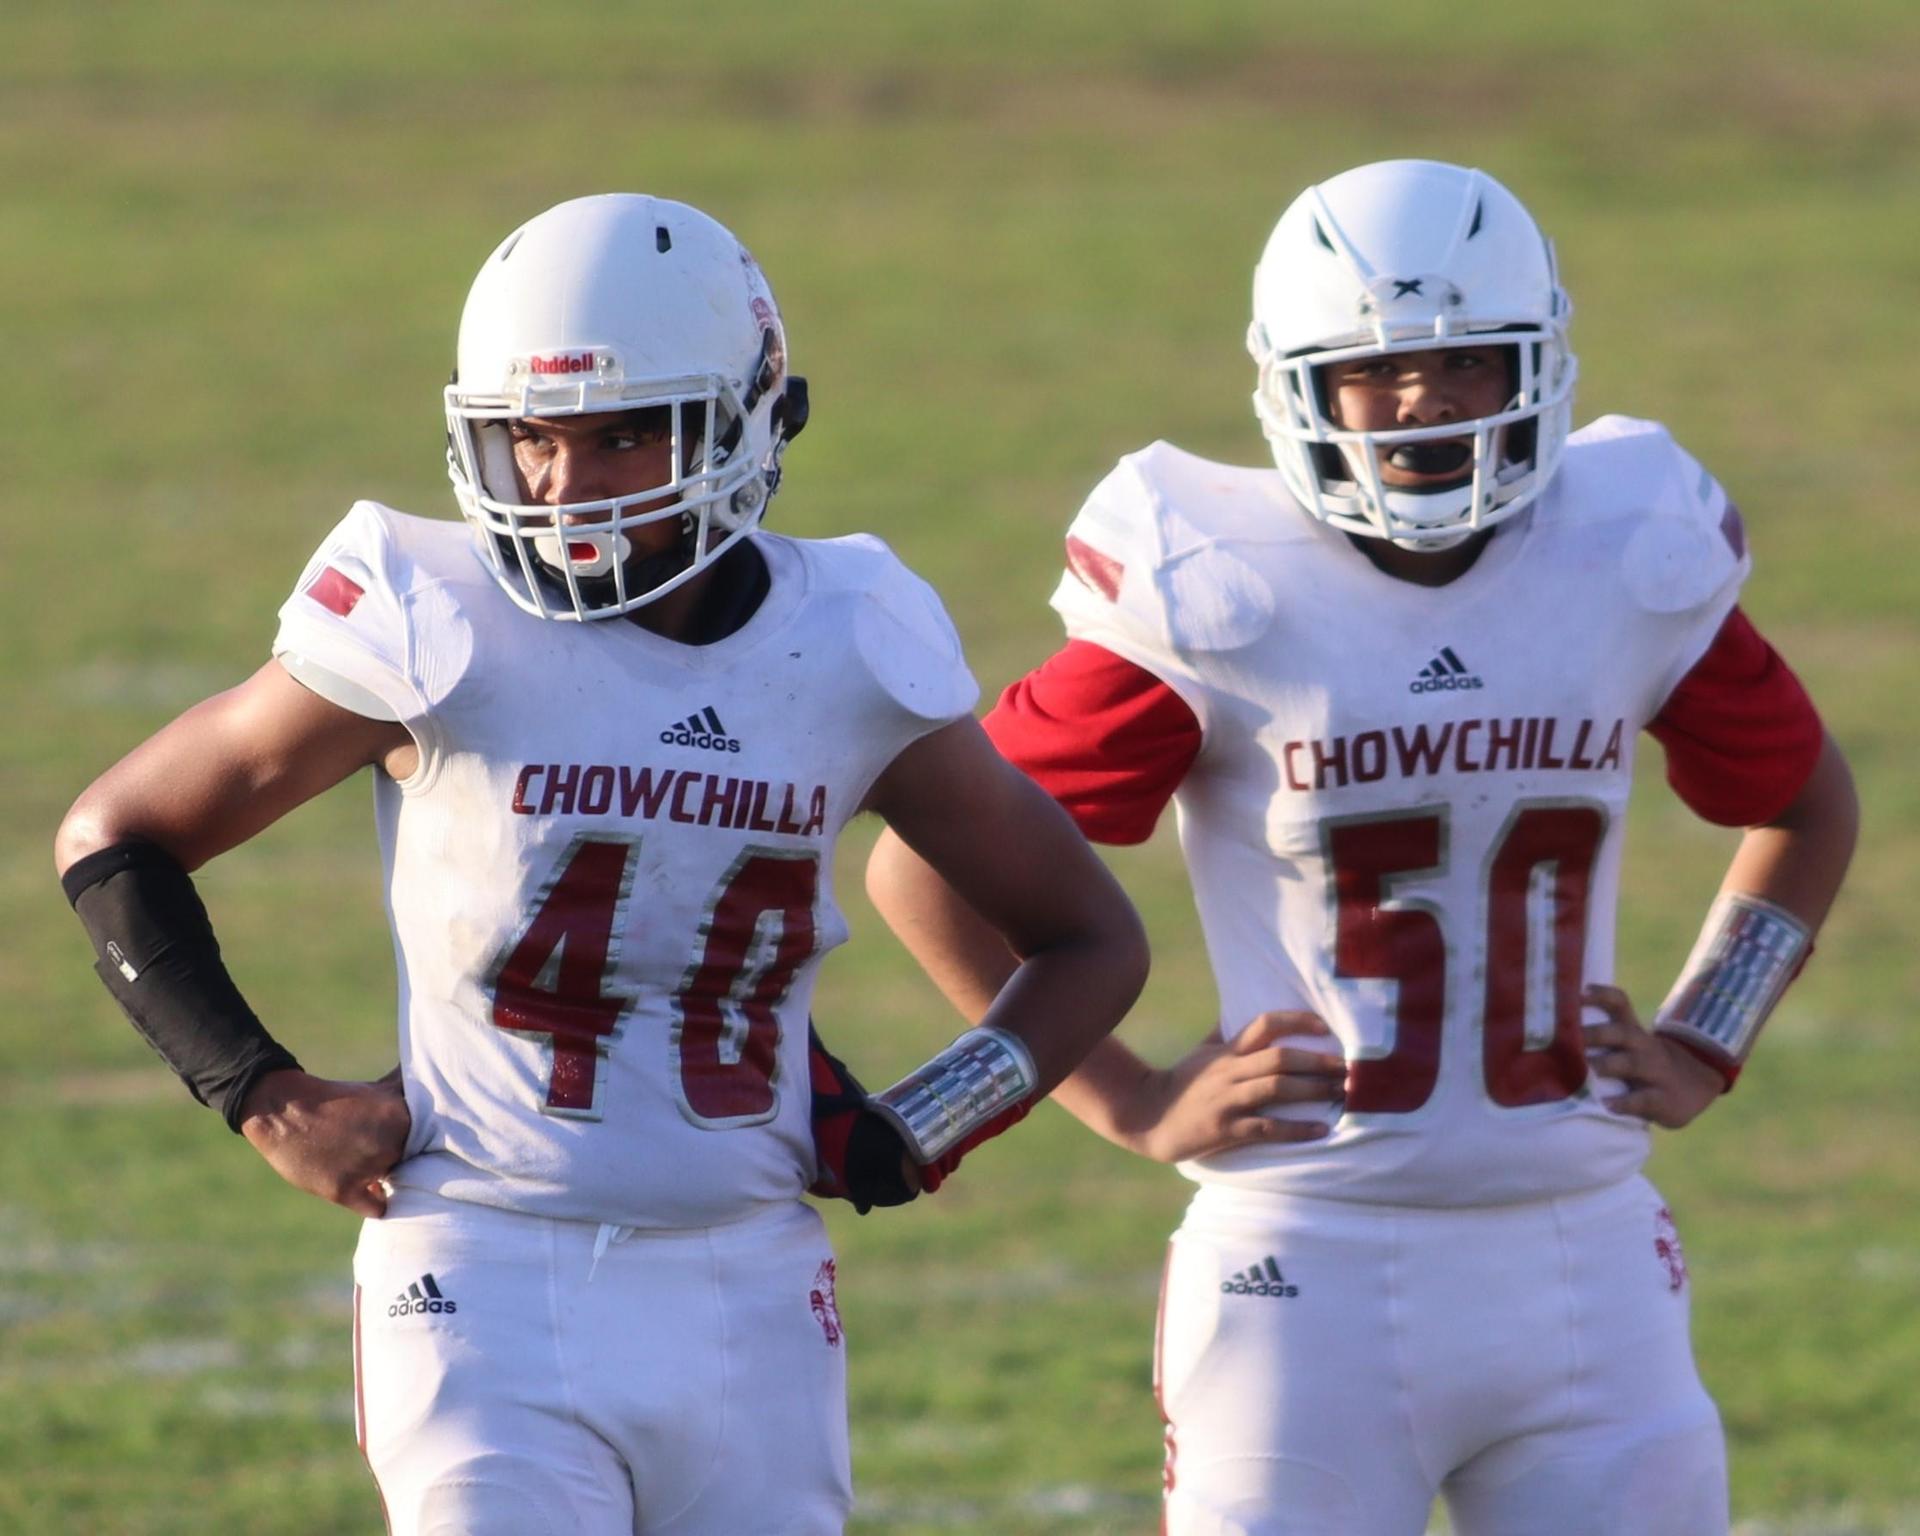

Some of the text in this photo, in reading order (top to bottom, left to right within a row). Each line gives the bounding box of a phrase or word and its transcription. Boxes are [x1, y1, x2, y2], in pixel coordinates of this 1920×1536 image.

[531, 353, 593, 374] Riddell
[1409, 674, 1484, 694] adidas
[660, 730, 741, 753] adidas
[1284, 717, 1624, 791] CHOWCHILLA
[511, 764, 827, 836] CHOWCHILLA
[1318, 796, 1610, 1117] 50
[484, 830, 821, 1130] 40
[1220, 1280, 1298, 1298] adidas
[388, 1298, 457, 1317] adidas
